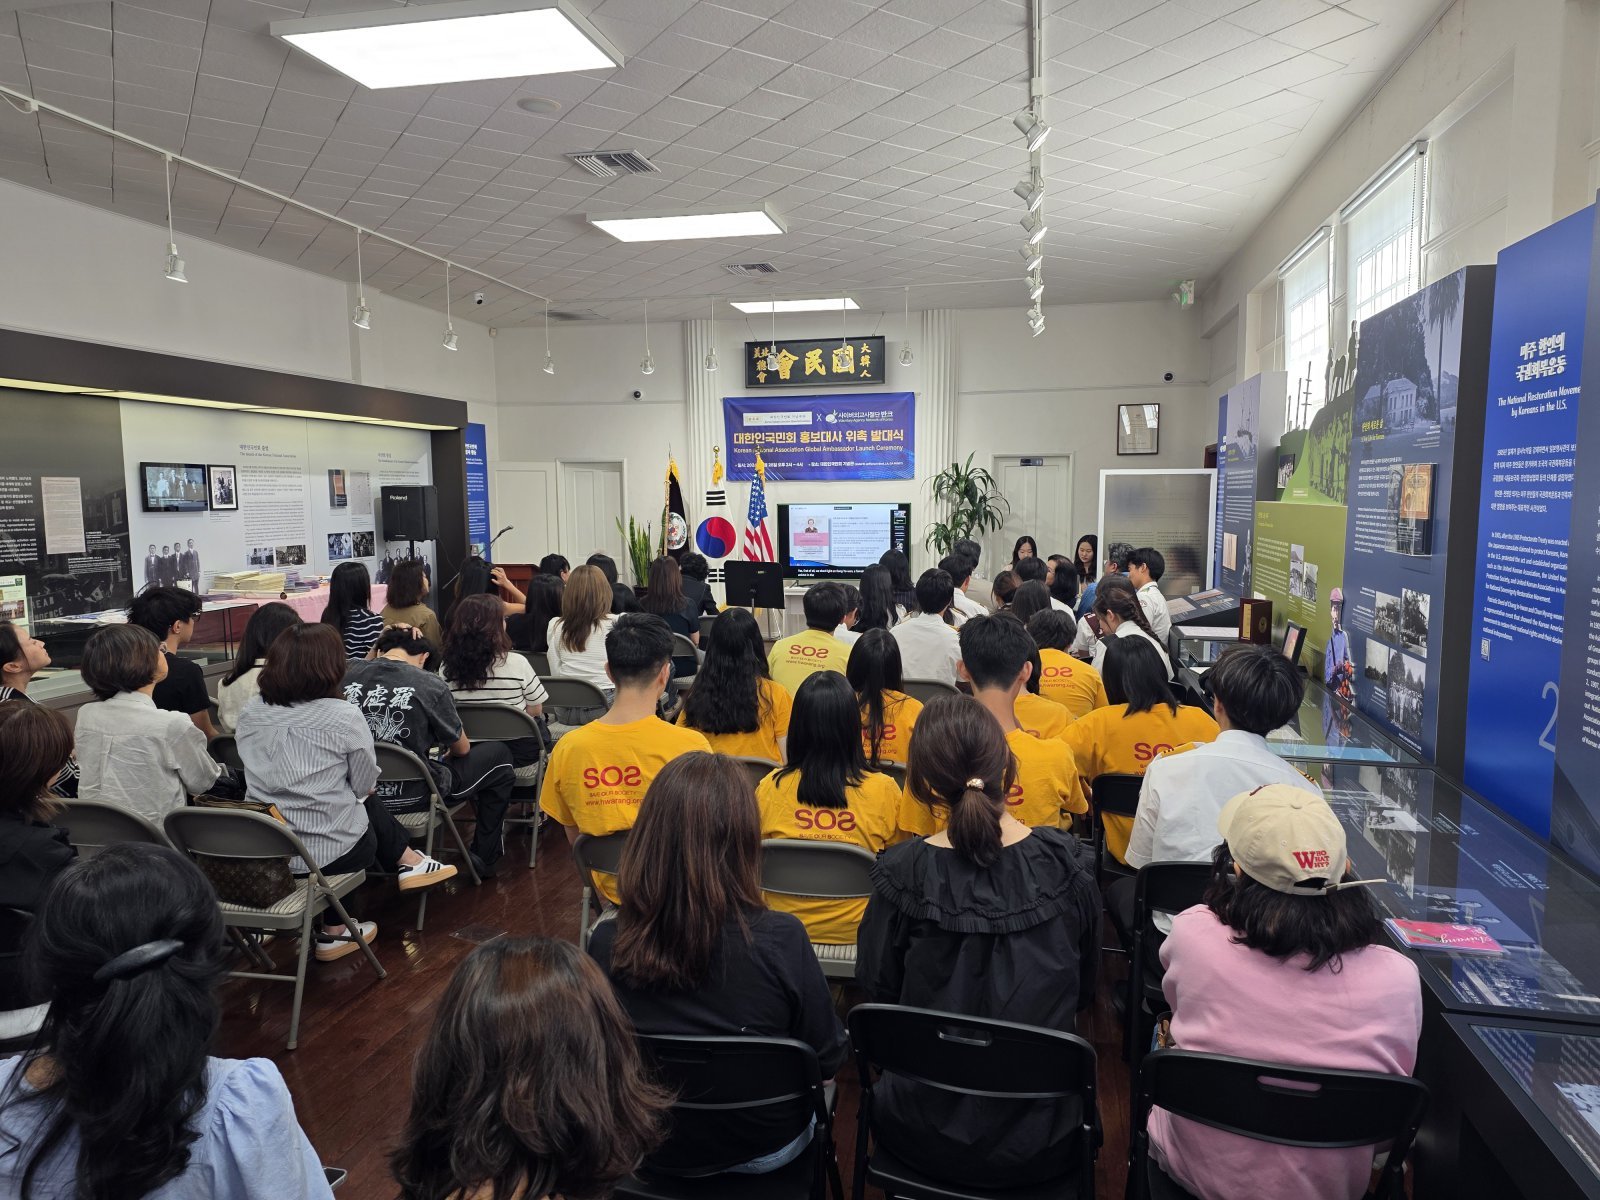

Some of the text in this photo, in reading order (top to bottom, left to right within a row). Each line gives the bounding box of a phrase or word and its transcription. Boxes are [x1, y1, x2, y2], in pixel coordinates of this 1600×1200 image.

[1520, 332, 1566, 360] 미주 한인의
[1516, 355, 1567, 382] 국권회복운동
[1498, 398, 1506, 406] The
[1506, 393, 1526, 404] National
[1528, 389, 1558, 402] Restoration
[1511, 399, 1567, 418] by Koreans in the U.S.
[734, 429, 904, 444] 대한인국민회 홍보대사 위촉 발대식
[789, 645, 828, 658] SOS
[1043, 667, 1073, 677] OS
[584, 766, 642, 788] SOS
[795, 809, 856, 831] SOS
